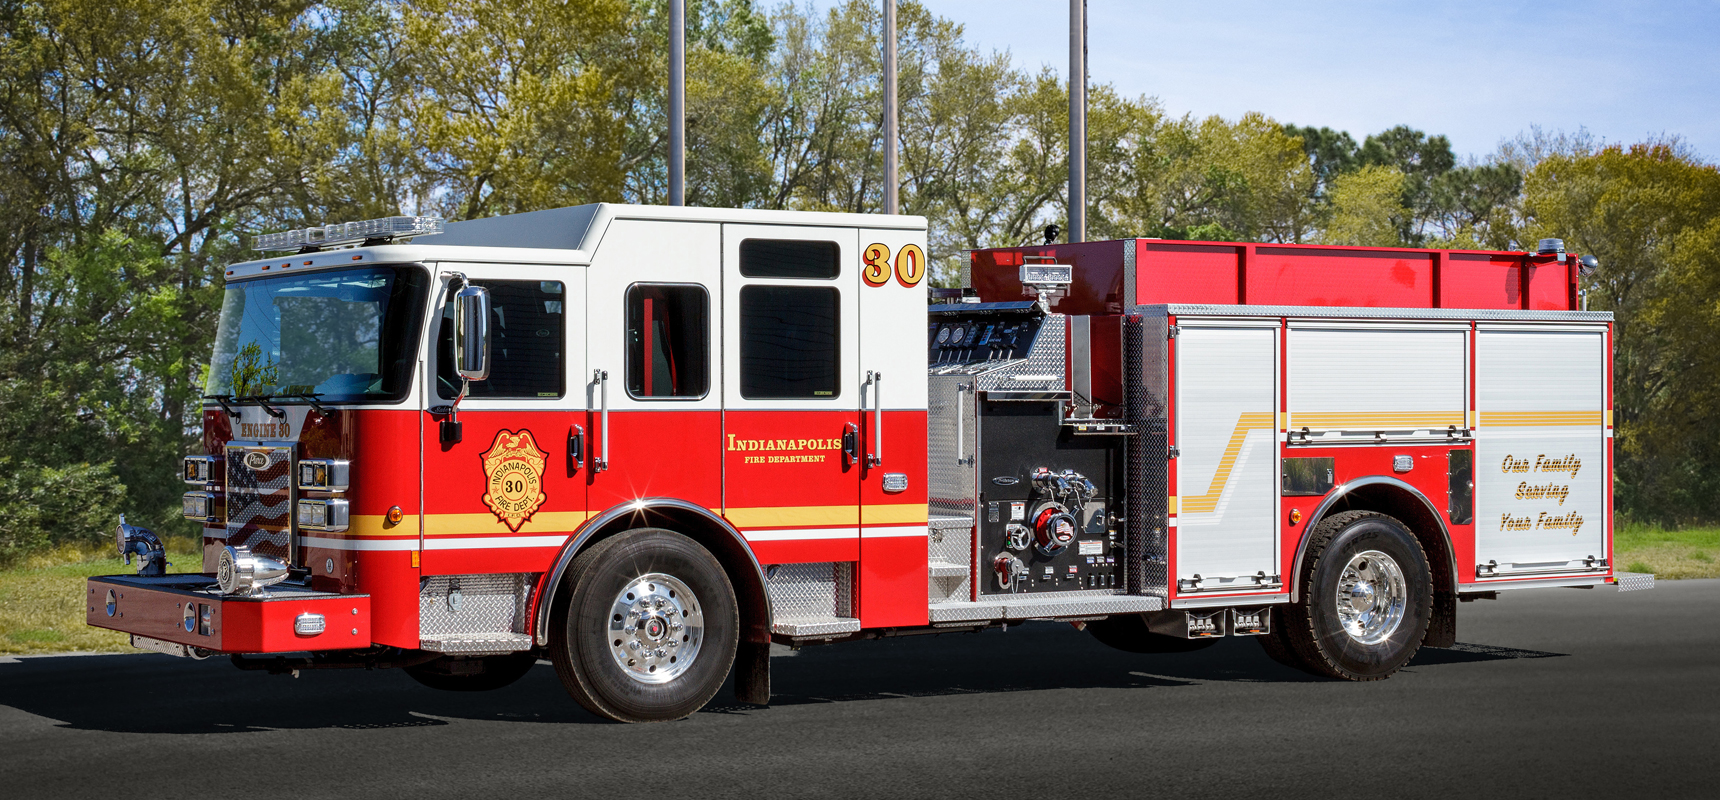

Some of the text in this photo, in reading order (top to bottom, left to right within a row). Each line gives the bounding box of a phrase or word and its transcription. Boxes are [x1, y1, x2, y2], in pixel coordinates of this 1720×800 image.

[862, 242, 926, 289] 30
[241, 422, 291, 438] ENGINE 30
[744, 455, 826, 464] FIRE DEPARTMENT
[1501, 453, 1582, 479] Our Family
[492, 462, 537, 485] INDIANAPOLIS
[505, 480, 523, 493] 30
[1514, 481, 1569, 506] Serving
[495, 495, 535, 511] FIRE DEPT.
[1500, 510, 1584, 536] Your Family
